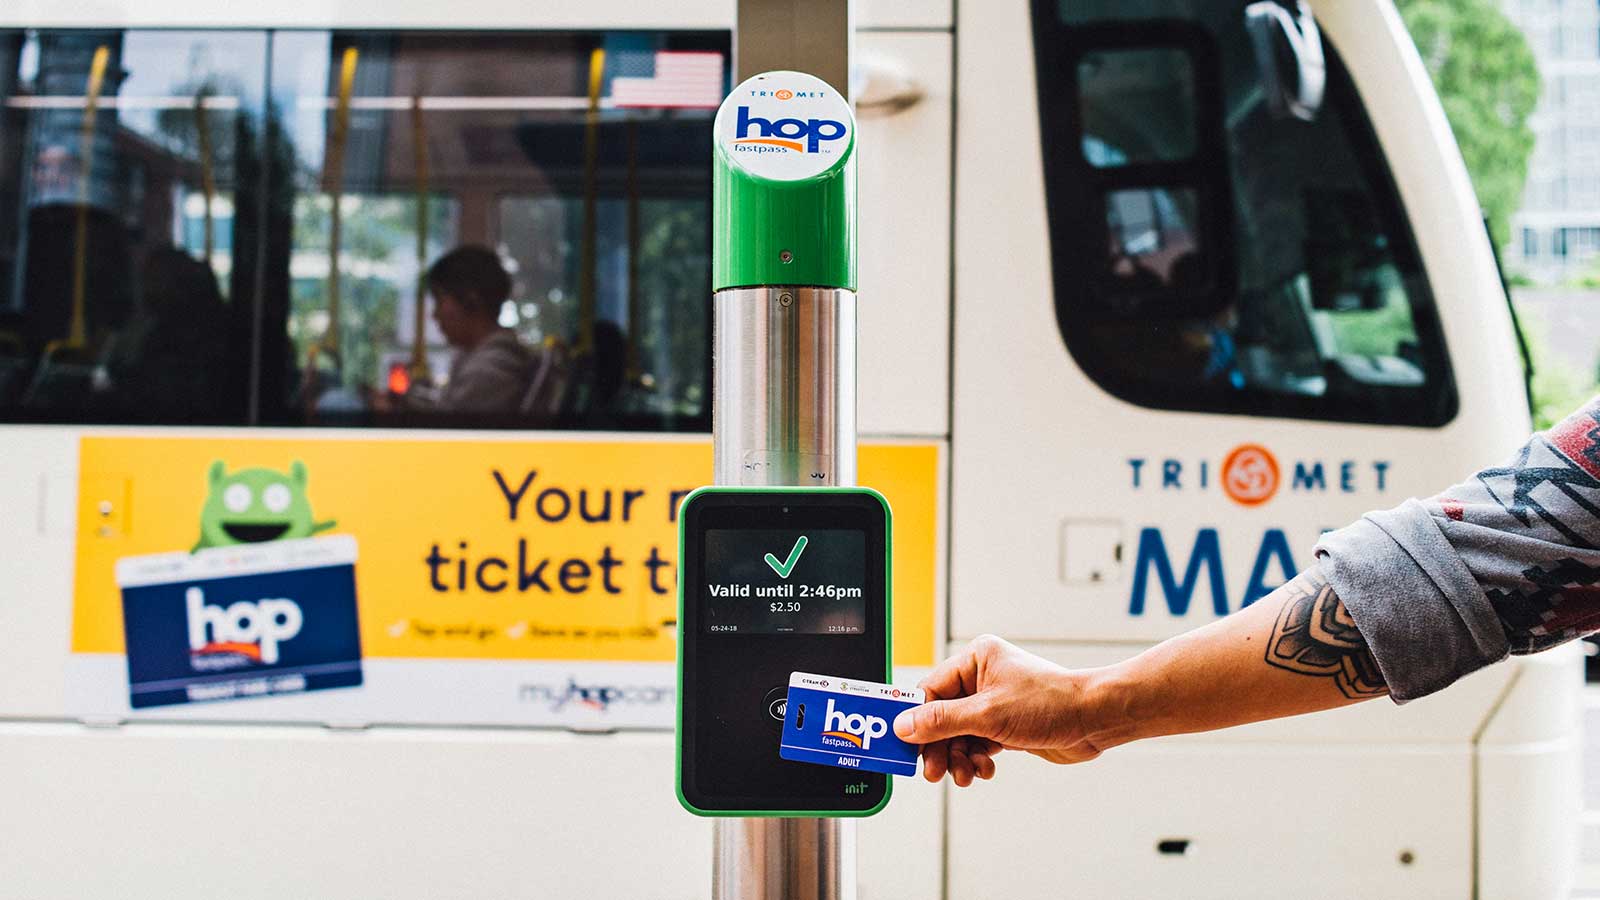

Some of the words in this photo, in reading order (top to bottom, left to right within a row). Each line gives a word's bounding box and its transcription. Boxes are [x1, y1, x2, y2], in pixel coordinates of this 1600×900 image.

[736, 106, 846, 154] hop
[734, 143, 788, 154] fastpass
[492, 469, 646, 523] Your
[425, 537, 624, 595] ticket
[644, 546, 678, 595] t
[1127, 527, 1335, 617] MA
[708, 584, 750, 598] Valid
[756, 584, 794, 598] until
[799, 585, 862, 600] 2:46pm
[770, 602, 800, 612] $2.50
[186, 586, 303, 664] hop
[823, 698, 888, 750] hop
[822, 736, 852, 747] fastpass
[837, 756, 861, 767] ADULT
[845, 782, 868, 794] init
